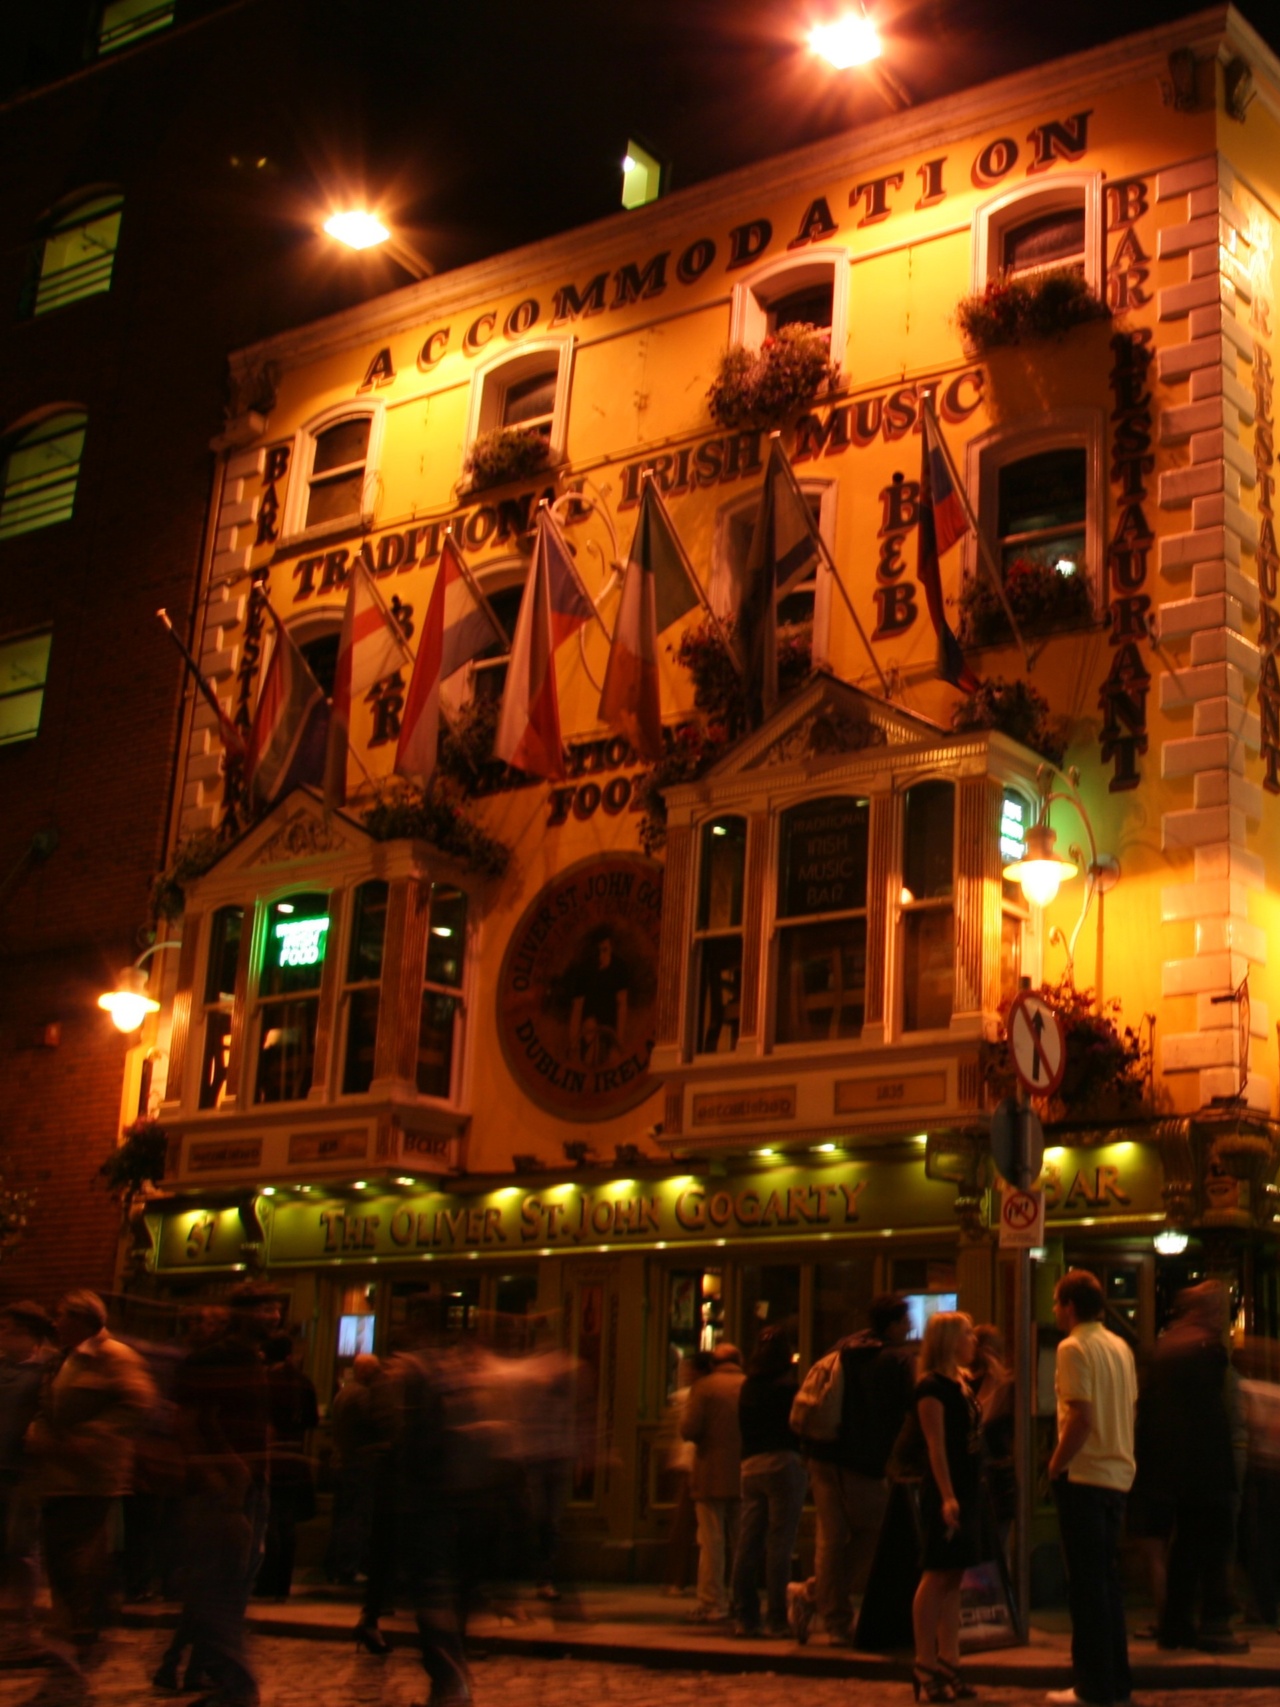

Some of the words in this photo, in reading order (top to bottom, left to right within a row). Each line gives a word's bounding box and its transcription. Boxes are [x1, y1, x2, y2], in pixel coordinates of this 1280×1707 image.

[357, 110, 1094, 393] ACCOMMODATION
[1106, 180, 1153, 315] BAR
[256, 446, 290, 546] BAR
[618, 430, 763, 510] IRISH
[792, 367, 986, 463] MUSIC
[1098, 327, 1156, 793] RESTAURANT
[513, 905, 558, 992] OLIVER
[583, 871, 637, 901] JOHN
[516, 1017, 587, 1093] DUBLIN
[319, 1207, 381, 1252] THE
[389, 1206, 508, 1249] OLIVER
[571, 1194, 661, 1245] JOHN
[674, 1179, 870, 1232] GOGARTY
[1042, 1161, 1132, 1209] BAR
